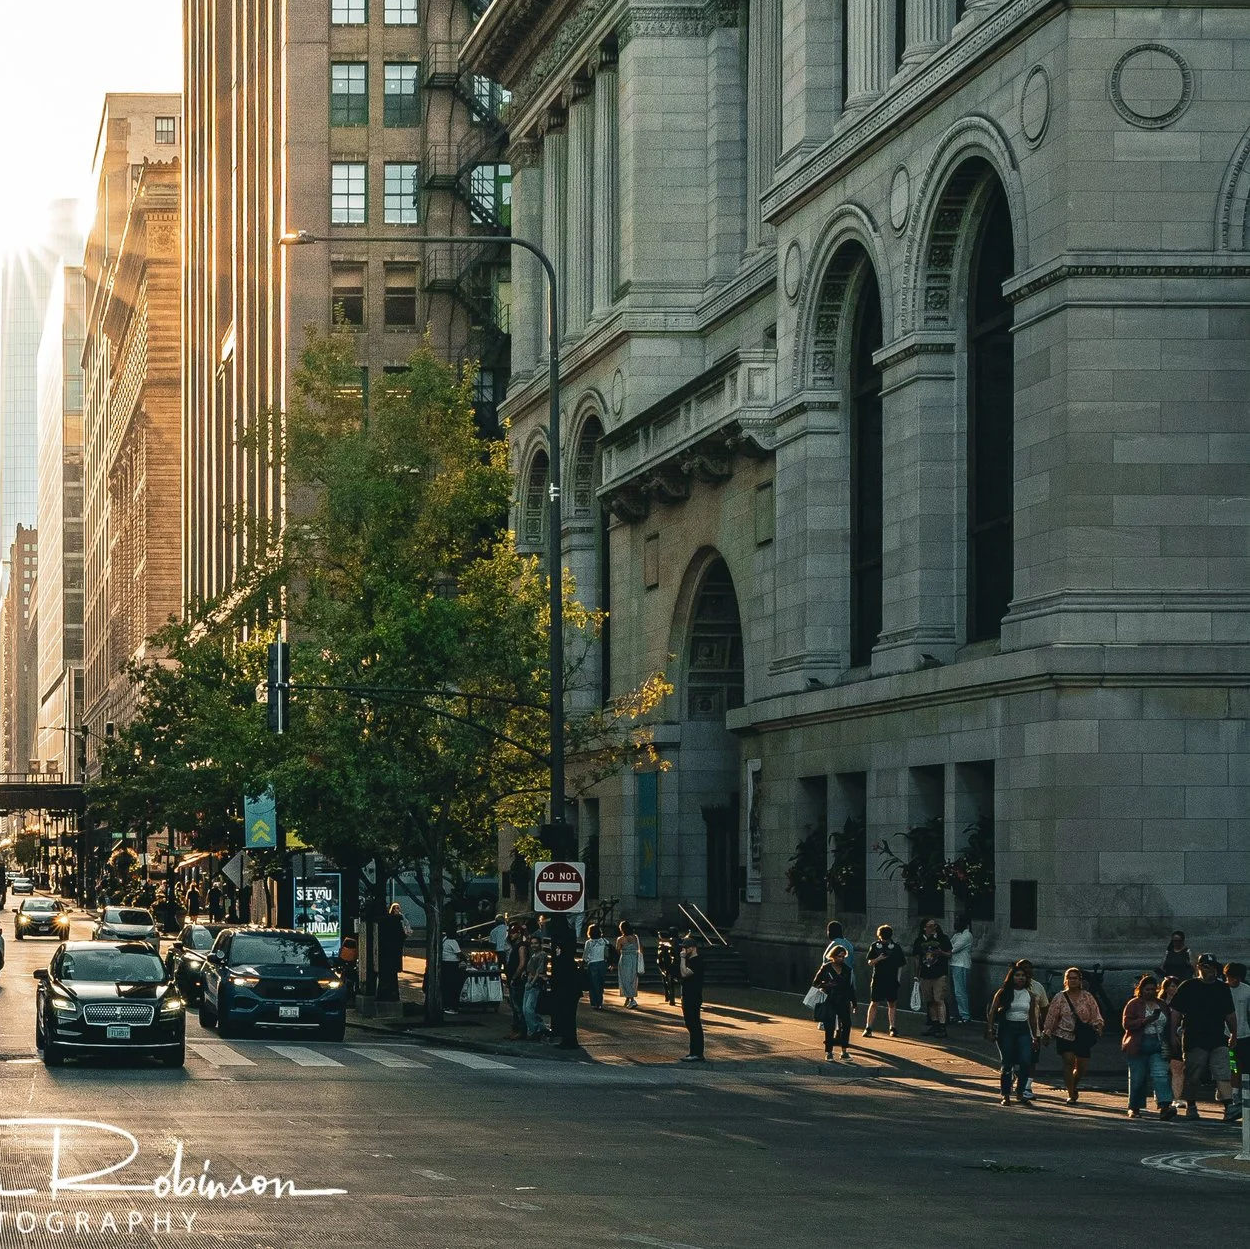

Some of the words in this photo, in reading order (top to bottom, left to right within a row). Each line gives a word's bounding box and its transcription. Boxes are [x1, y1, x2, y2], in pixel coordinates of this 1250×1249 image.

[542, 872, 555, 880] DO
[559, 872, 577, 881] NOT
[296, 889, 313, 901] SEE
[314, 889, 332, 901] YOU
